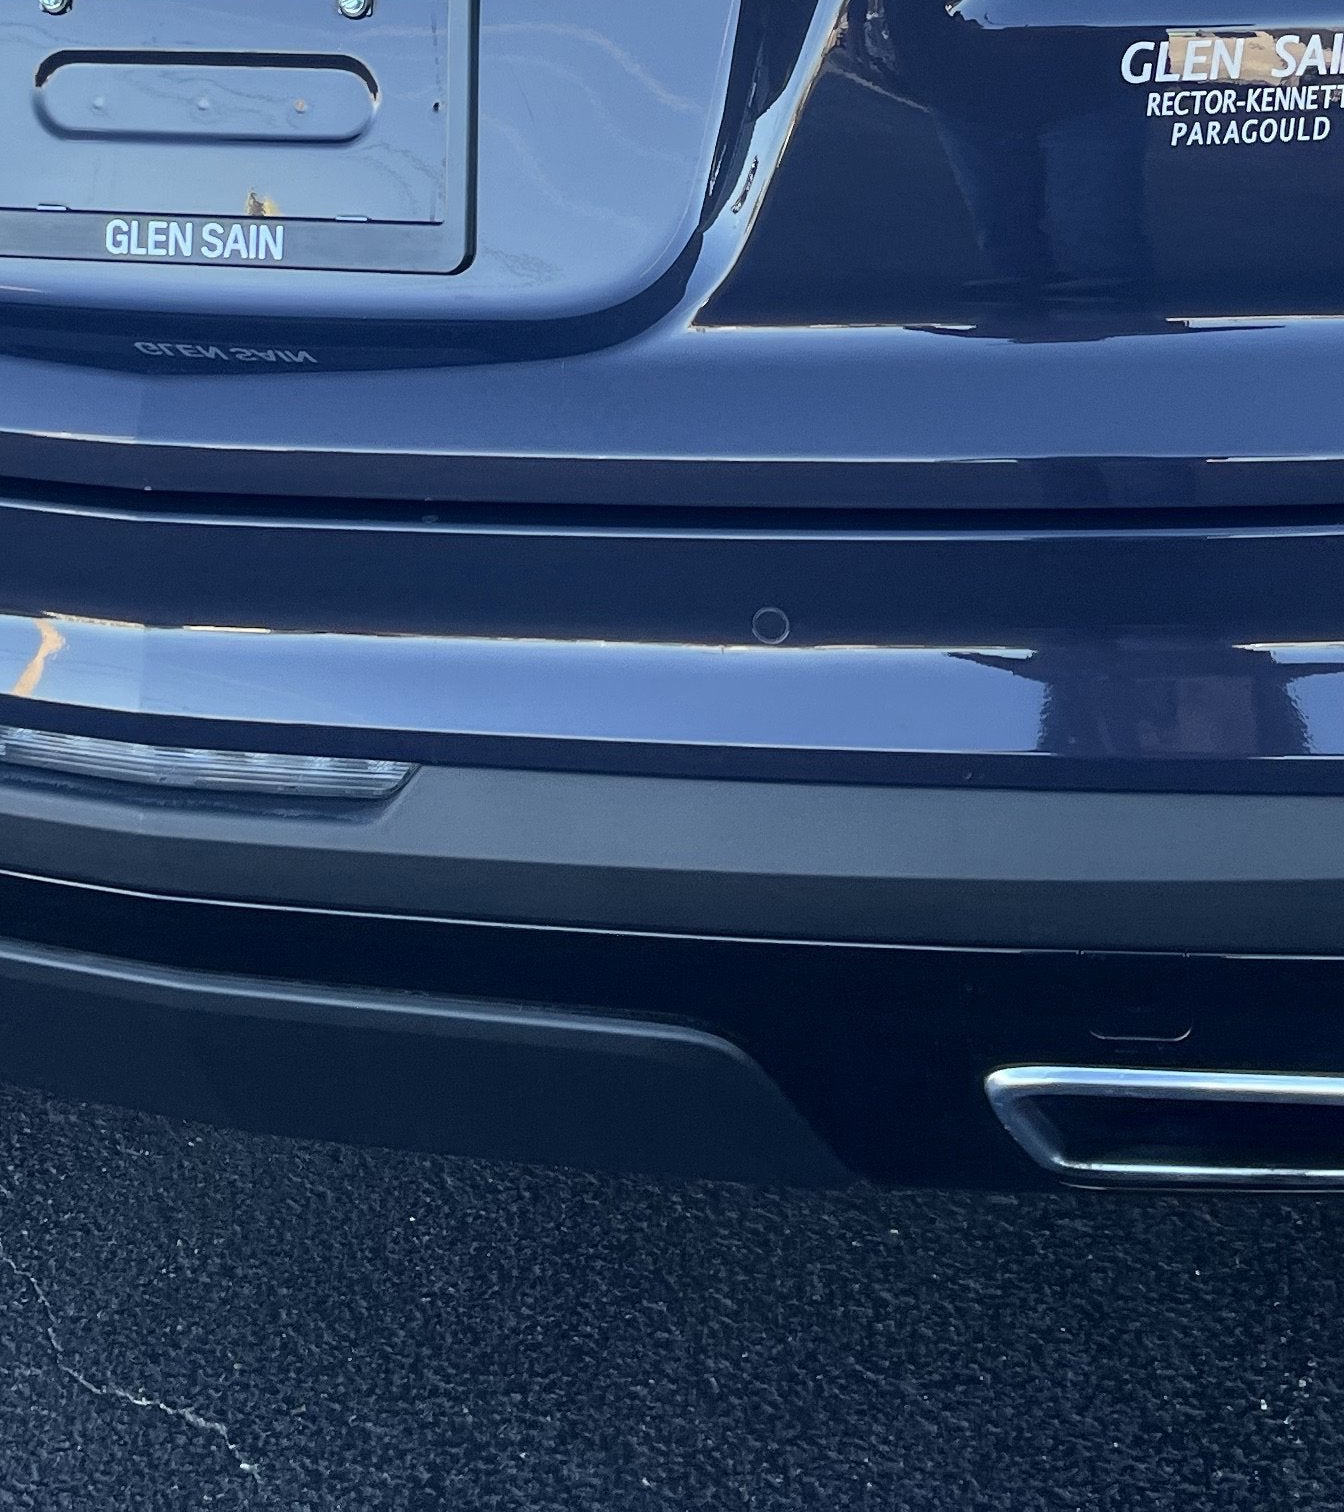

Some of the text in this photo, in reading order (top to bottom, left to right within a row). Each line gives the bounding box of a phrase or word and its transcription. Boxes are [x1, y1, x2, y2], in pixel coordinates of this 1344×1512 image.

[1121, 37, 1244, 84] GLEN
[1170, 116, 1331, 146] PARAGOULD
[106, 219, 284, 261] GLEN SAIN
